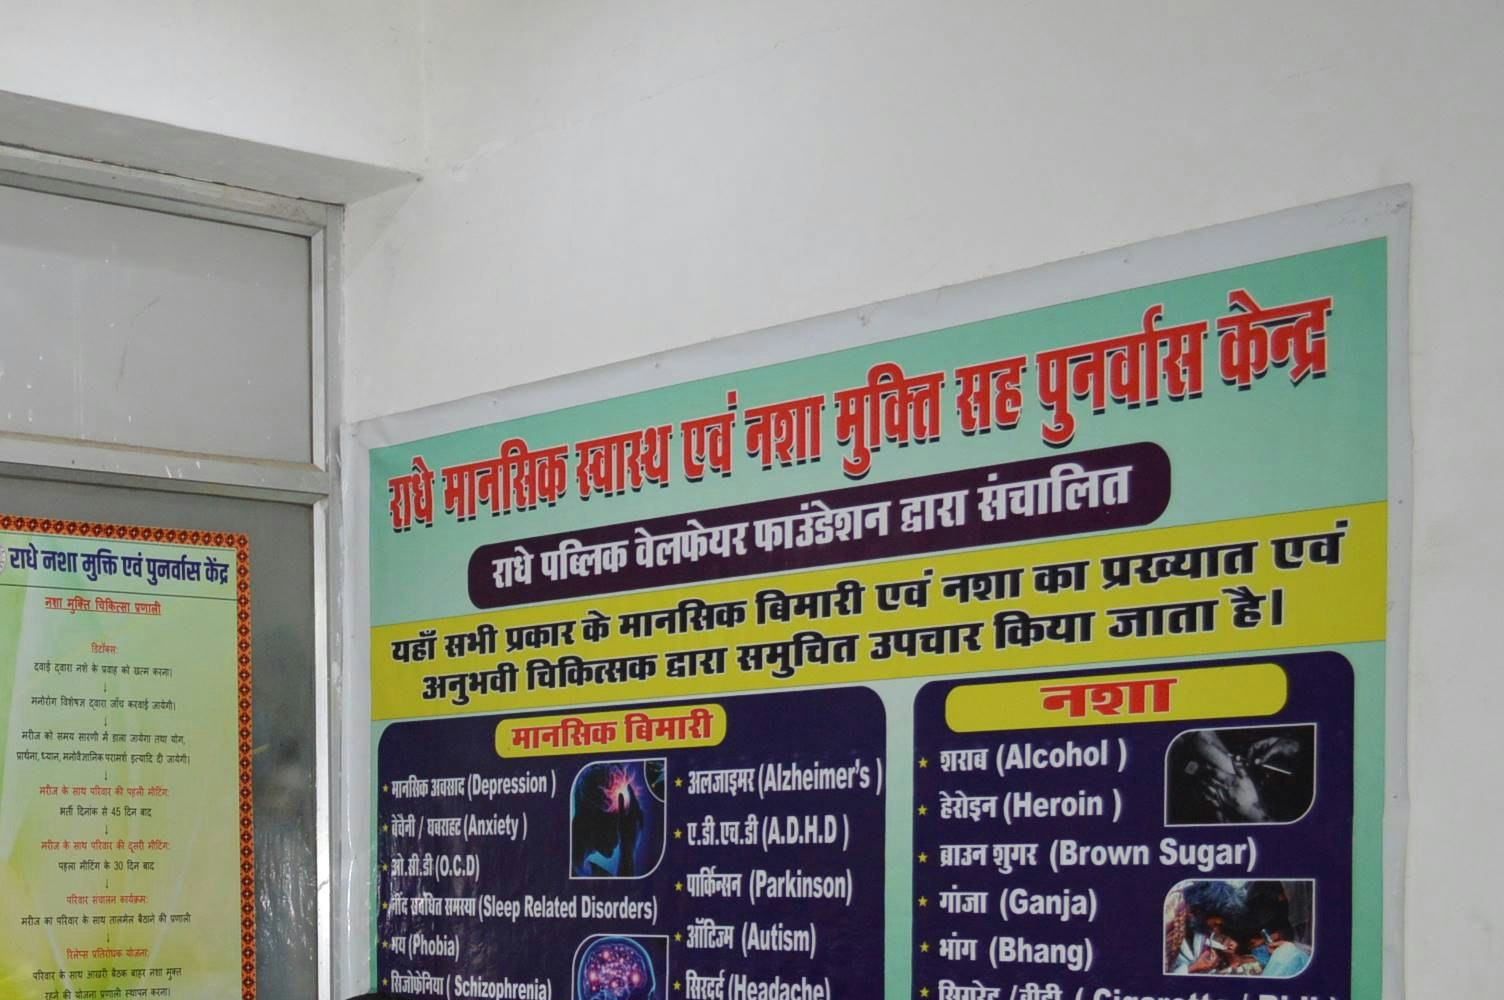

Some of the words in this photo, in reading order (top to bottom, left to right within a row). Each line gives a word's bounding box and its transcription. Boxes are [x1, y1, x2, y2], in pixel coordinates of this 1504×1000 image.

[387, 455, 437, 530] राधे
[440, 437, 570, 520] मानसिक
[680, 390, 738, 479] एवं
[744, 394, 826, 468] नशा
[834, 362, 947, 475] मुक्ति
[953, 354, 1028, 434] सह
[1035, 303, 1210, 444] पुनर्वास
[1215, 288, 1334, 388] केन्द्र
[491, 545, 535, 588] राधे
[539, 538, 629, 581] पब्लिक
[634, 518, 749, 568] वेलफेयर
[752, 499, 892, 552] फाउंडेशन
[899, 489, 969, 533] द्वारा
[977, 462, 1133, 522] संचालित
[7, 542, 38, 570] राधे
[40, 550, 78, 573] नशा
[80, 548, 118, 581] मुक्ति
[120, 551, 143, 577] एवं
[145, 554, 202, 586] पुनर्वास
[203, 556, 229, 584] केंद्र
[44, 596, 64, 608] नशा
[67, 596, 90, 613] मुक्ति
[95, 597, 131, 612] चिकित्सा
[135, 602, 161, 614] प्रणाली
[391, 629, 437, 663] यहाँ
[444, 623, 498, 658] सभी
[505, 620, 576, 653] प्रकार
[581, 610, 611, 642] के
[618, 598, 747, 638] मानसिक
[755, 579, 866, 625] बिमारी
[874, 568, 933, 611] एवं
[941, 568, 1024, 603] नशा
[1031, 560, 1090, 594] का
[1100, 541, 1258, 590] प्रख्यात
[1270, 519, 1348, 569] एवं
[422, 662, 519, 705] अनुभवी
[526, 654, 658, 690] चिकित्सक
[664, 647, 728, 677] द्वारा
[736, 631, 859, 678] समुचित
[868, 622, 984, 659] उपचार
[993, 610, 1096, 649] किया
[1106, 599, 1219, 637] जाता
[1039, 678, 1177, 717] नशा
[511, 717, 617, 749] मानसिक
[625, 708, 713, 743] बिमारी
[939, 748, 989, 772] शराब
[391, 774, 429, 799] मानसिक
[430, 777, 466, 797] अवसाद
[687, 767, 756, 797] अलजाइमर
[101, 805, 108, 816] से
[110, 806, 121, 817] 45
[123, 805, 137, 816] दिन
[140, 807, 152, 817] बाद
[938, 790, 999, 822] हेरोइन
[686, 813, 759, 846] ए.डी.एच.डी
[390, 852, 434, 880] ओ.सी.डी
[435, 854, 480, 882] (O.C.D)
[939, 844, 989, 867] ब्राउन
[992, 843, 1039, 874] शुगर
[1049, 839, 1150, 873] (Brown
[1159, 836, 1257, 872] Sugar)
[749, 868, 853, 906] (Parkinson)
[938, 884, 989, 914] गांजा
[999, 887, 1097, 922] (Ganja)
[478, 894, 521, 923] (Sleep
[523, 894, 577, 918] Related
[408, 931, 459, 962] (Phobia)
[686, 917, 735, 949] ऑटिज्म
[741, 921, 816, 959] (Autism)
[939, 931, 978, 961] भांग
[989, 935, 1093, 972] (Bhang)
[685, 968, 725, 1000] सिरदर्द
